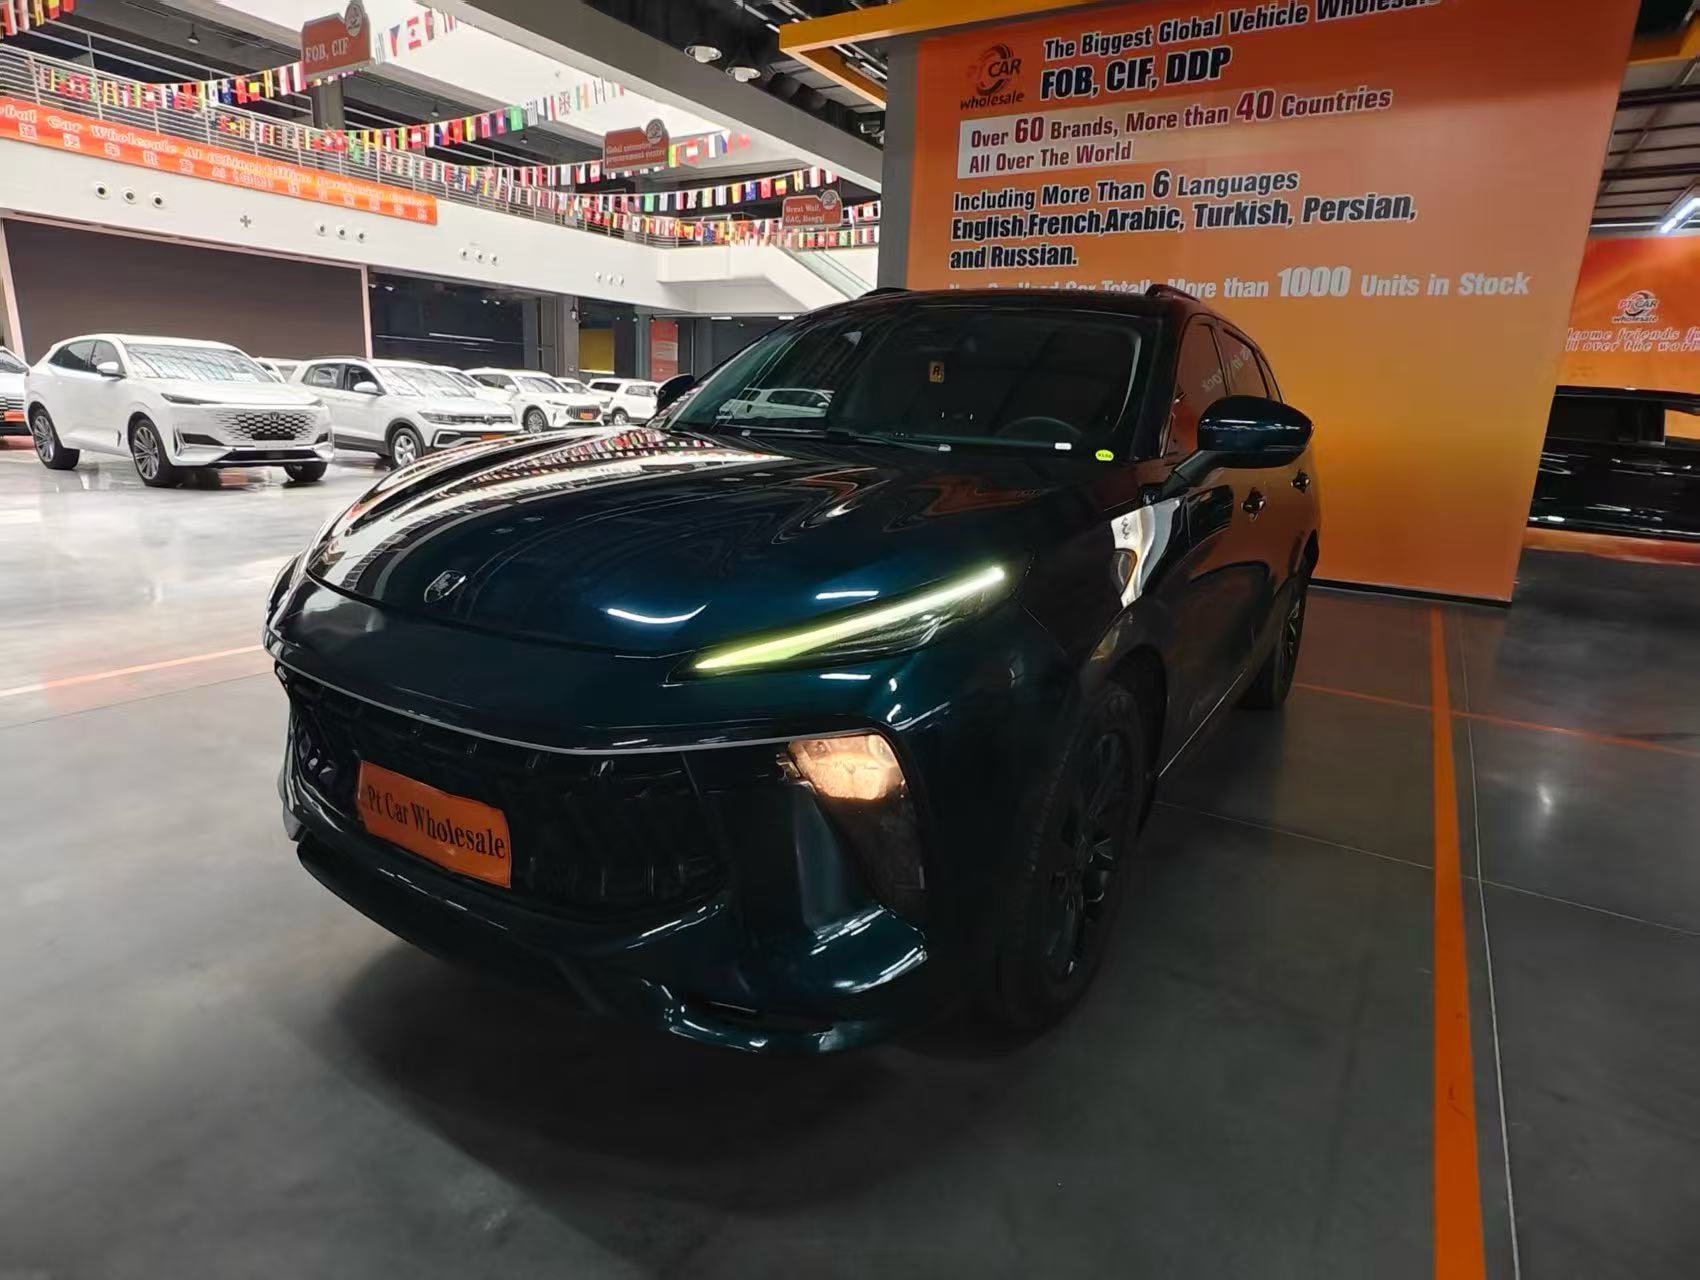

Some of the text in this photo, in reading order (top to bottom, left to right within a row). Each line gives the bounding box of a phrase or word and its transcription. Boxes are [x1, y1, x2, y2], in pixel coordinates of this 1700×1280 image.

[1045, 41, 1074, 59] The
[1082, 27, 1152, 55] Biggest
[1159, 14, 1221, 43] Global
[1229, 4, 1308, 33] Vehicle
[988, 58, 1021, 77] CAR
[1040, 47, 1231, 100] FOB, CIF, DDP
[960, 90, 1025, 110] wholesale
[971, 87, 1392, 148] Over 60 Brands, More than 40 Countries
[969, 141, 1132, 174] All Over The World
[954, 170, 1299, 211] Including More Than 6 Languages
[1193, 200, 1294, 228] Turkish,
[1303, 194, 1417, 224] Persian,
[950, 244, 1079, 270] and Russian.
[1224, 277, 1268, 297] than
[1278, 266, 1350, 297] 1000
[1360, 274, 1419, 296] Units
[1427, 274, 1449, 296] in
[1460, 271, 1530, 296] Stock
[1583, 342, 1619, 352] over
[1624, 340, 1652, 352] the
[367, 785, 505, 859] Pt Car Wholesale
